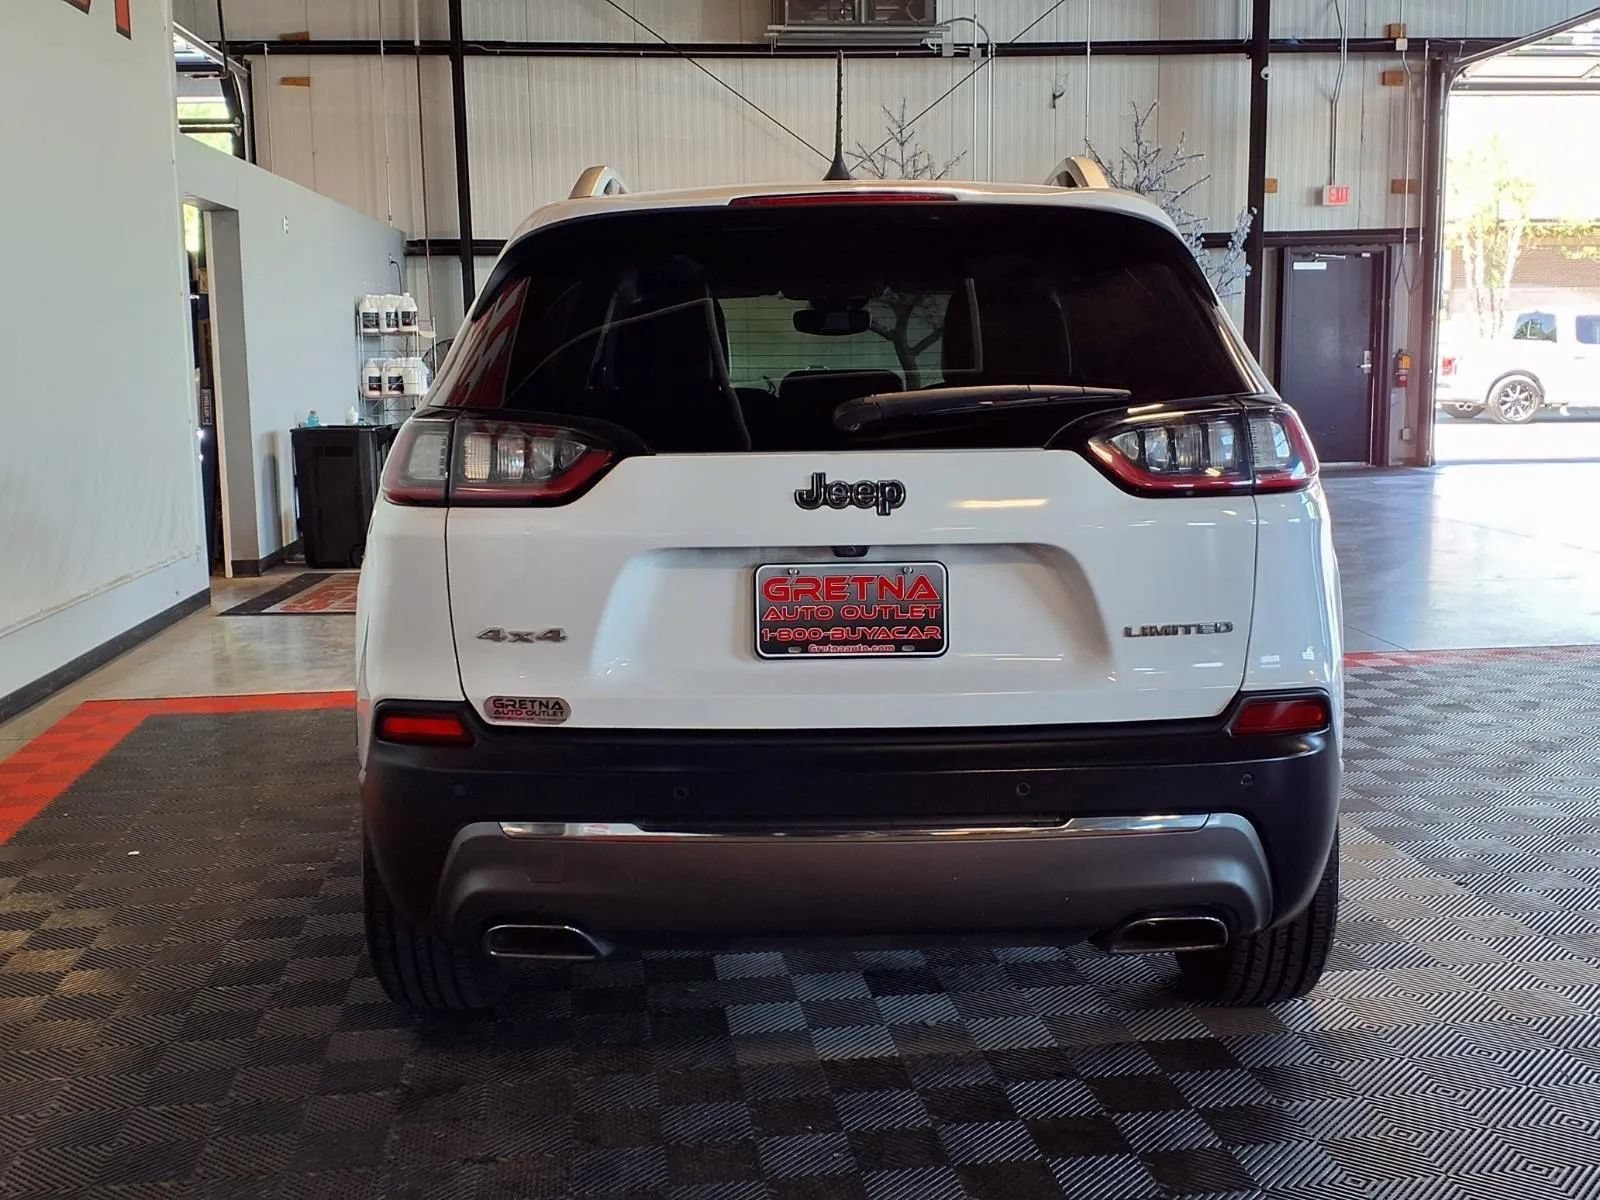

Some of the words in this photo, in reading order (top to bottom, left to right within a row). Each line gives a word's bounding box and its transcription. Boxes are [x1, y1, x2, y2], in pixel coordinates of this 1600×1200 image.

[794, 472, 906, 516] Jeep
[762, 574, 940, 602] GRETNA
[762, 605, 834, 621] AUTO
[840, 604, 942, 621] OUTLET
[761, 626, 942, 642] 1-800-BUYACAR
[1123, 621, 1233, 638] LIMITED
[808, 643, 896, 653] Gretnaauto.com
[493, 698, 564, 710] GRETNA
